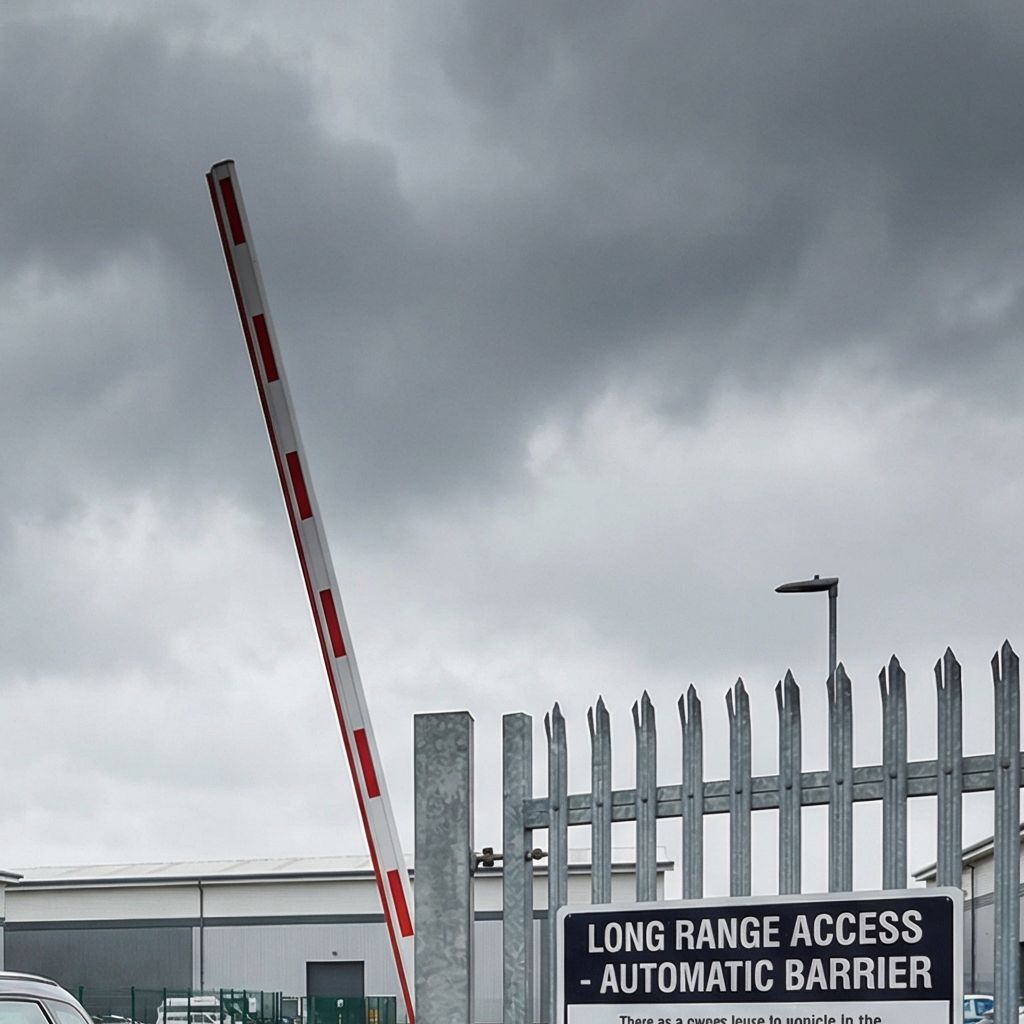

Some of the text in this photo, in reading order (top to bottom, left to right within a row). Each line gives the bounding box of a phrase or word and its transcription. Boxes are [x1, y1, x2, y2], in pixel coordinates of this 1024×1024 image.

[588, 910, 923, 954] LONG RANGE ACCESS
[599, 958, 774, 994] AUTOMATIC
[786, 955, 932, 991] BARRIER
